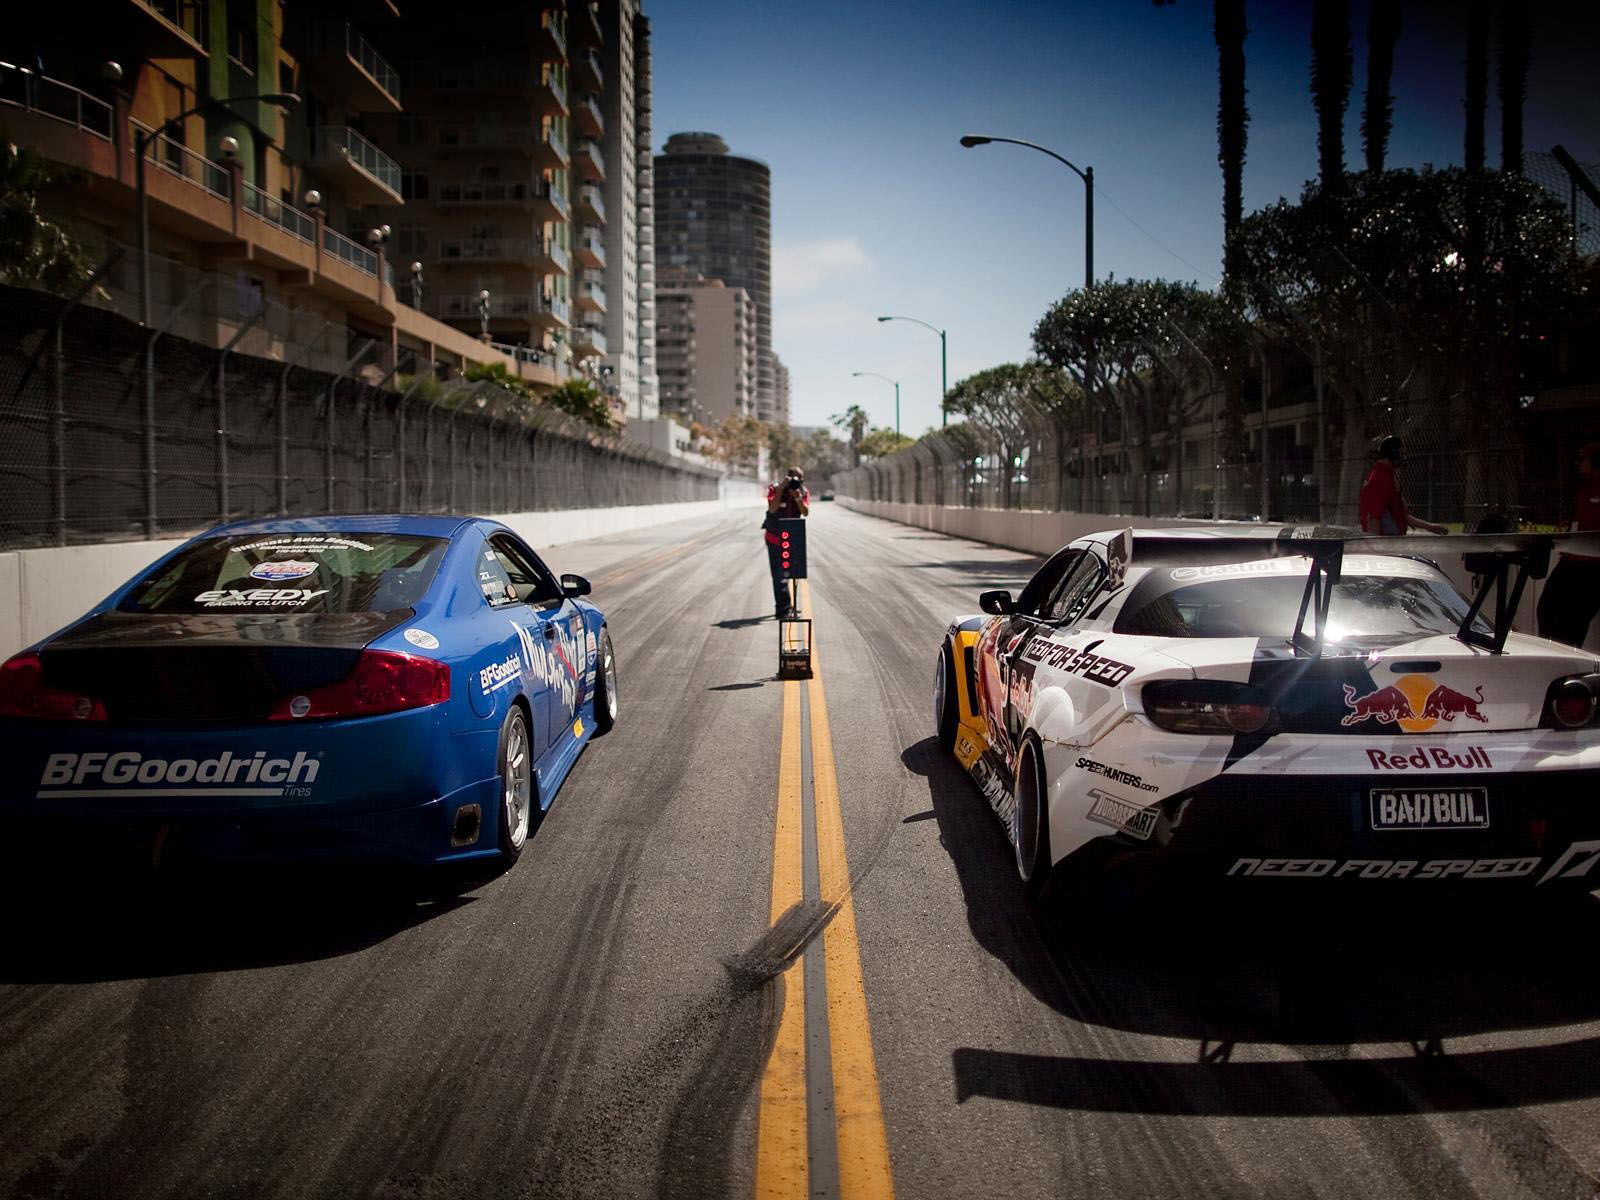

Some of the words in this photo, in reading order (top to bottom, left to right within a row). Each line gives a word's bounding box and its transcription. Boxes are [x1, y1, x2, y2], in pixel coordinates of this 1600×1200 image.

[1199, 562, 1277, 575] Castrol
[194, 588, 330, 602] EXEDY
[480, 652, 521, 689] BFGoodrich
[1022, 638, 1054, 663] NEED
[1041, 644, 1078, 670] FOR
[1063, 651, 1136, 688] SPEED
[40, 751, 321, 785] BFGoodrich
[1366, 747, 1431, 770] Red
[1428, 746, 1493, 769] Bull
[284, 784, 312, 797] Tires
[1226, 858, 1337, 878] NEED
[1332, 859, 1420, 879] FOR
[1413, 856, 1543, 880] SPEED
